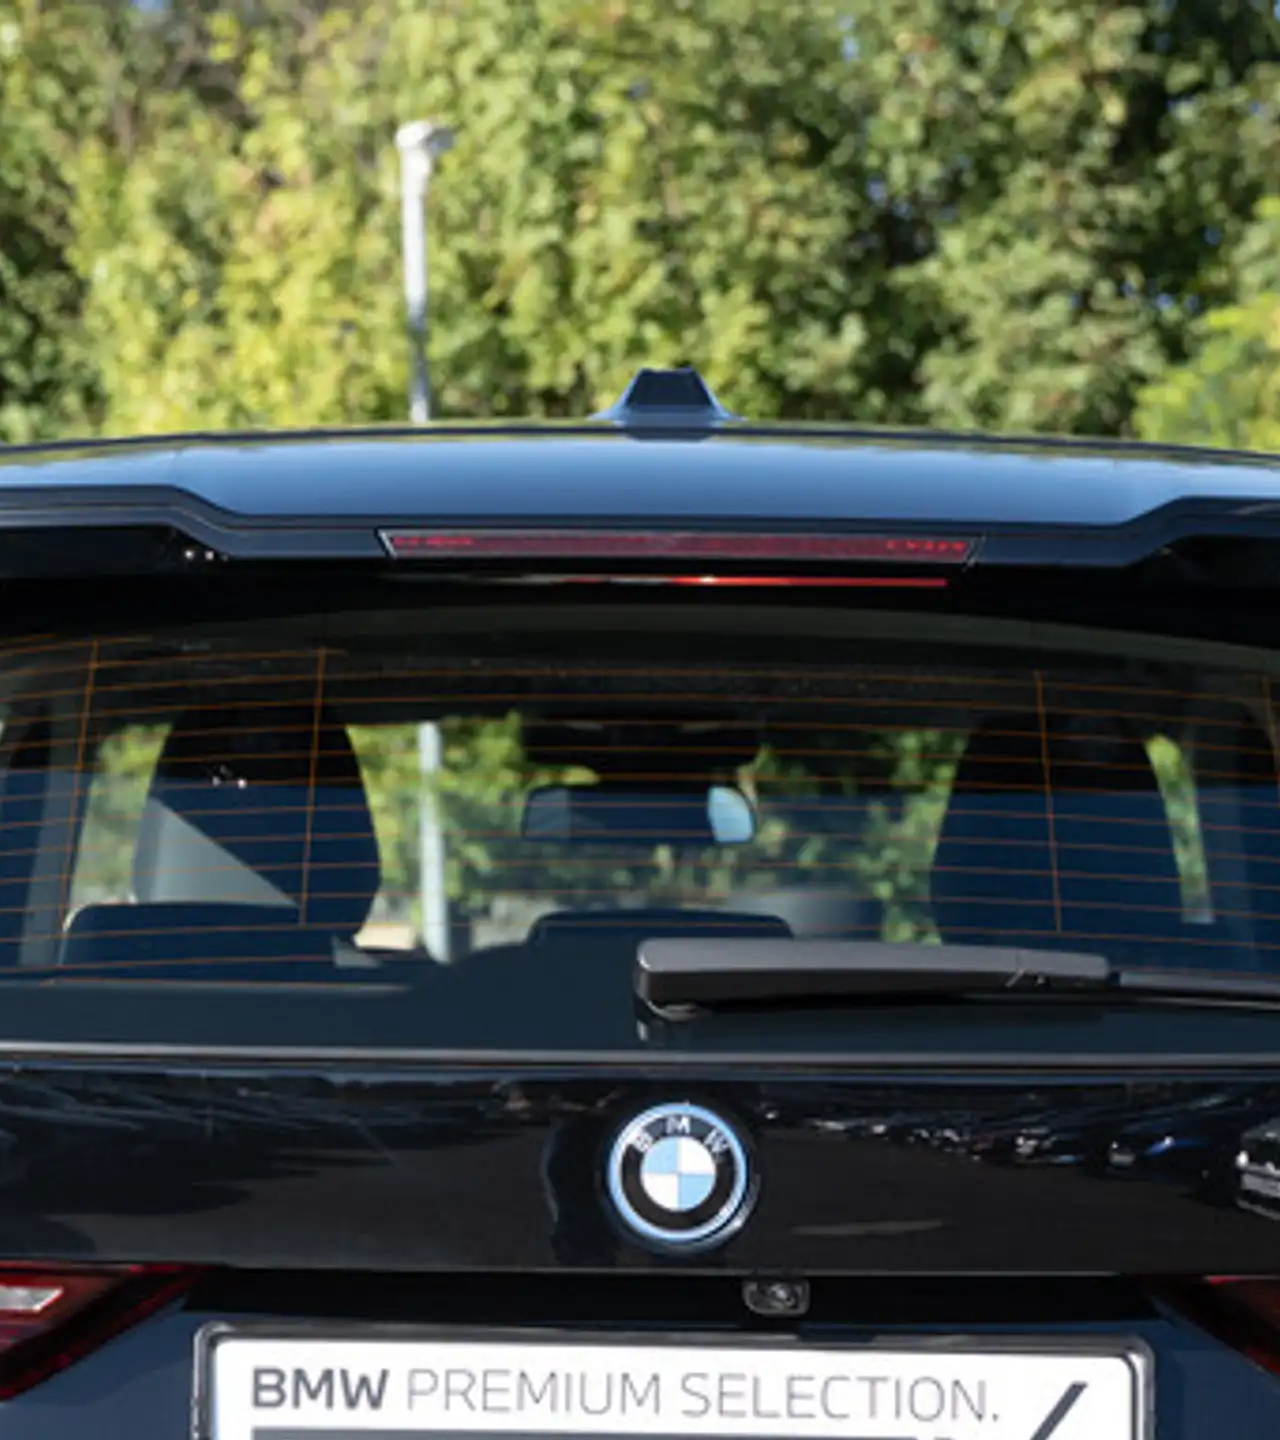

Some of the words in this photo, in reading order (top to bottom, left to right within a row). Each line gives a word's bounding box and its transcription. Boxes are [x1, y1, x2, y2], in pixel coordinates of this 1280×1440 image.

[623, 1114, 731, 1165] BMW
[251, 1366, 389, 1410] BMW
[407, 1368, 661, 1416] PREMIUM
[681, 1372, 1000, 1423] SELECTION.
